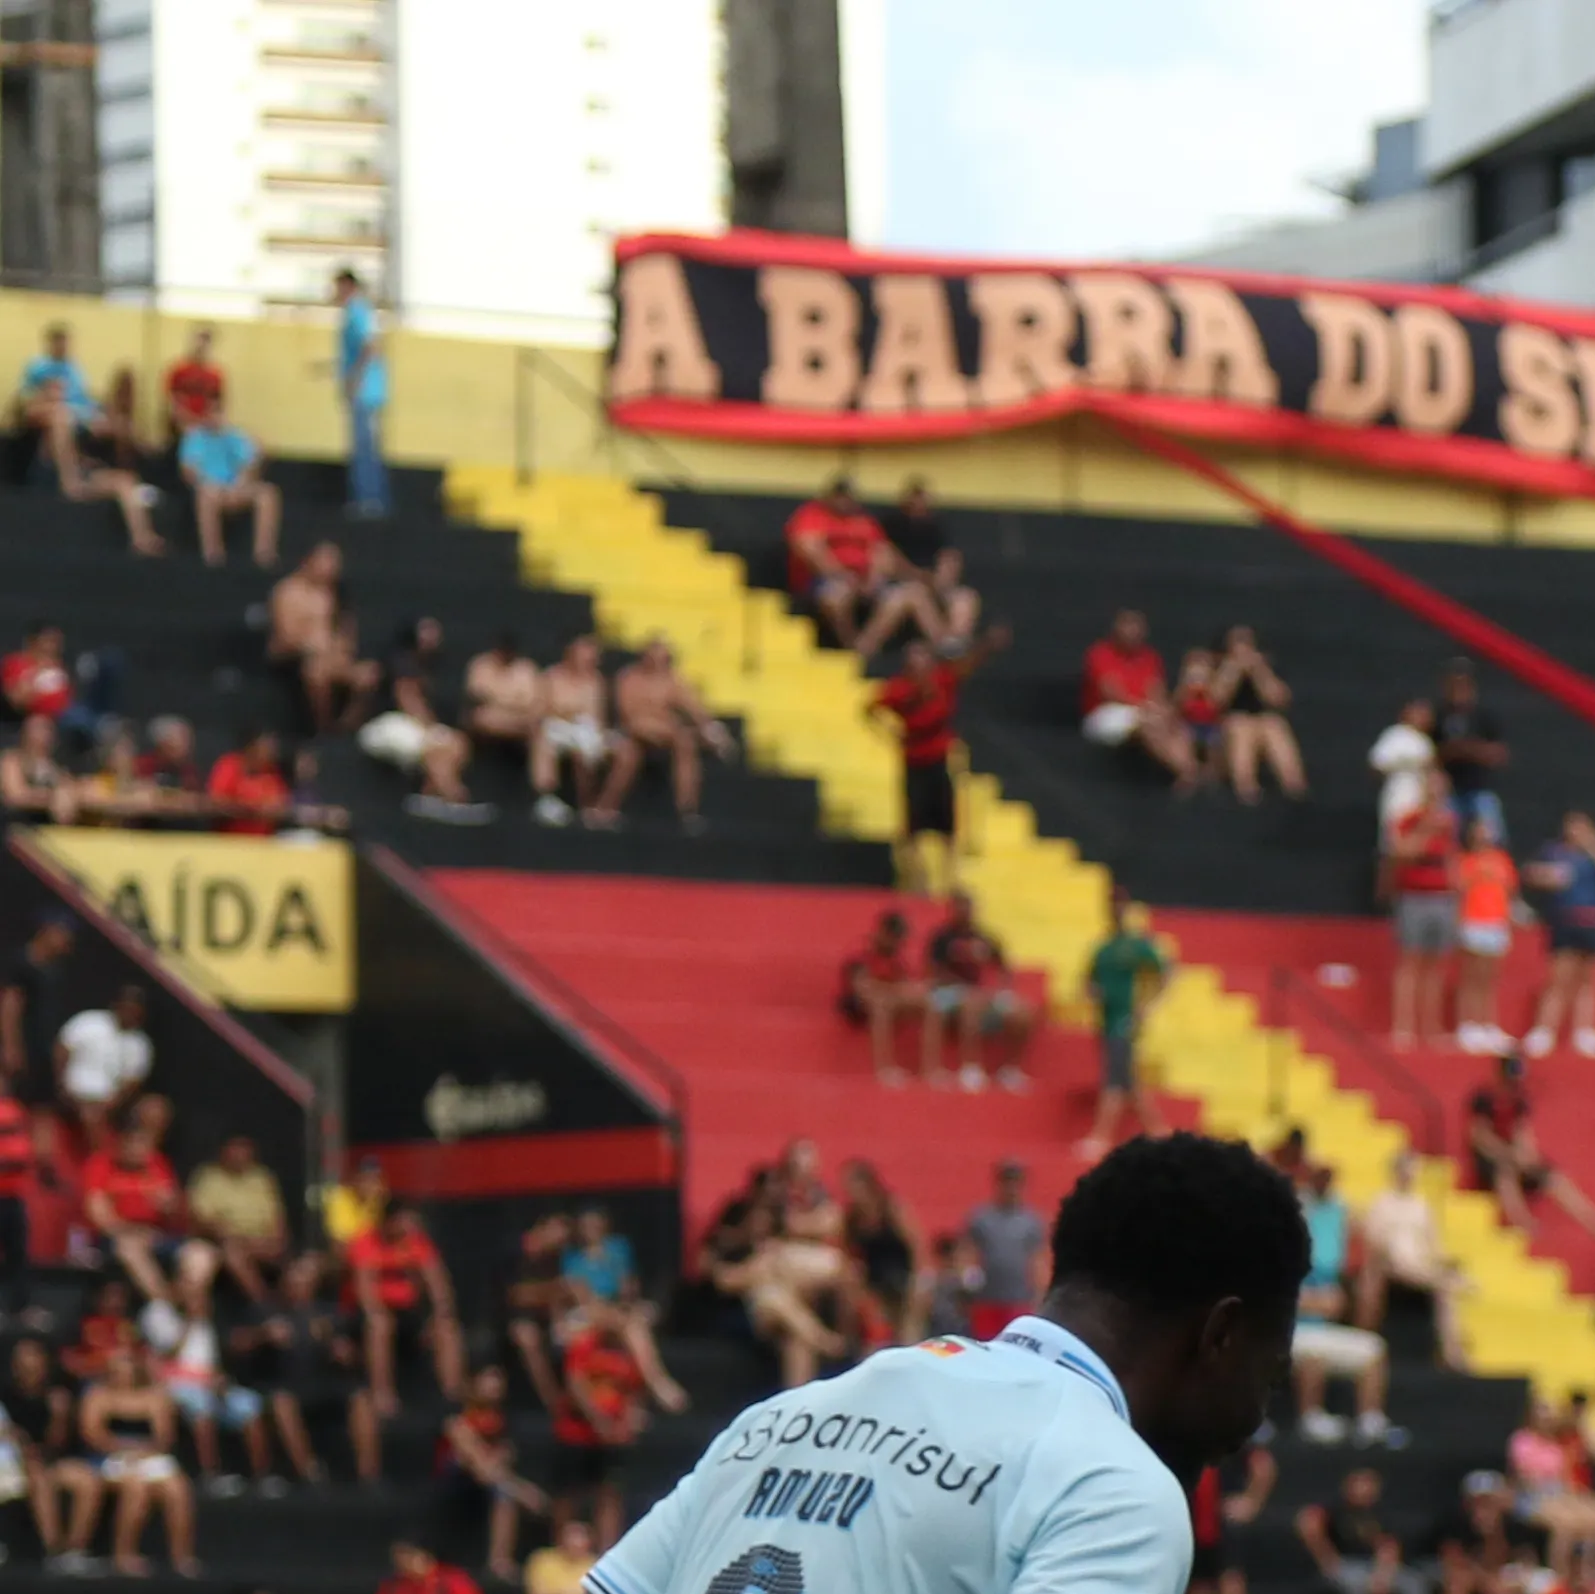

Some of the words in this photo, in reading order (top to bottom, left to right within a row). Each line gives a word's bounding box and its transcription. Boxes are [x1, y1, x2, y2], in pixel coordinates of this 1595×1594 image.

[609, 250, 720, 400] A
[757, 262, 1279, 418] BARRA
[1298, 294, 1474, 438] DO
[108, 857, 330, 958] AÍDA
[743, 1466, 875, 1530] AMUZU
[778, 1408, 1003, 1507] banrisul
